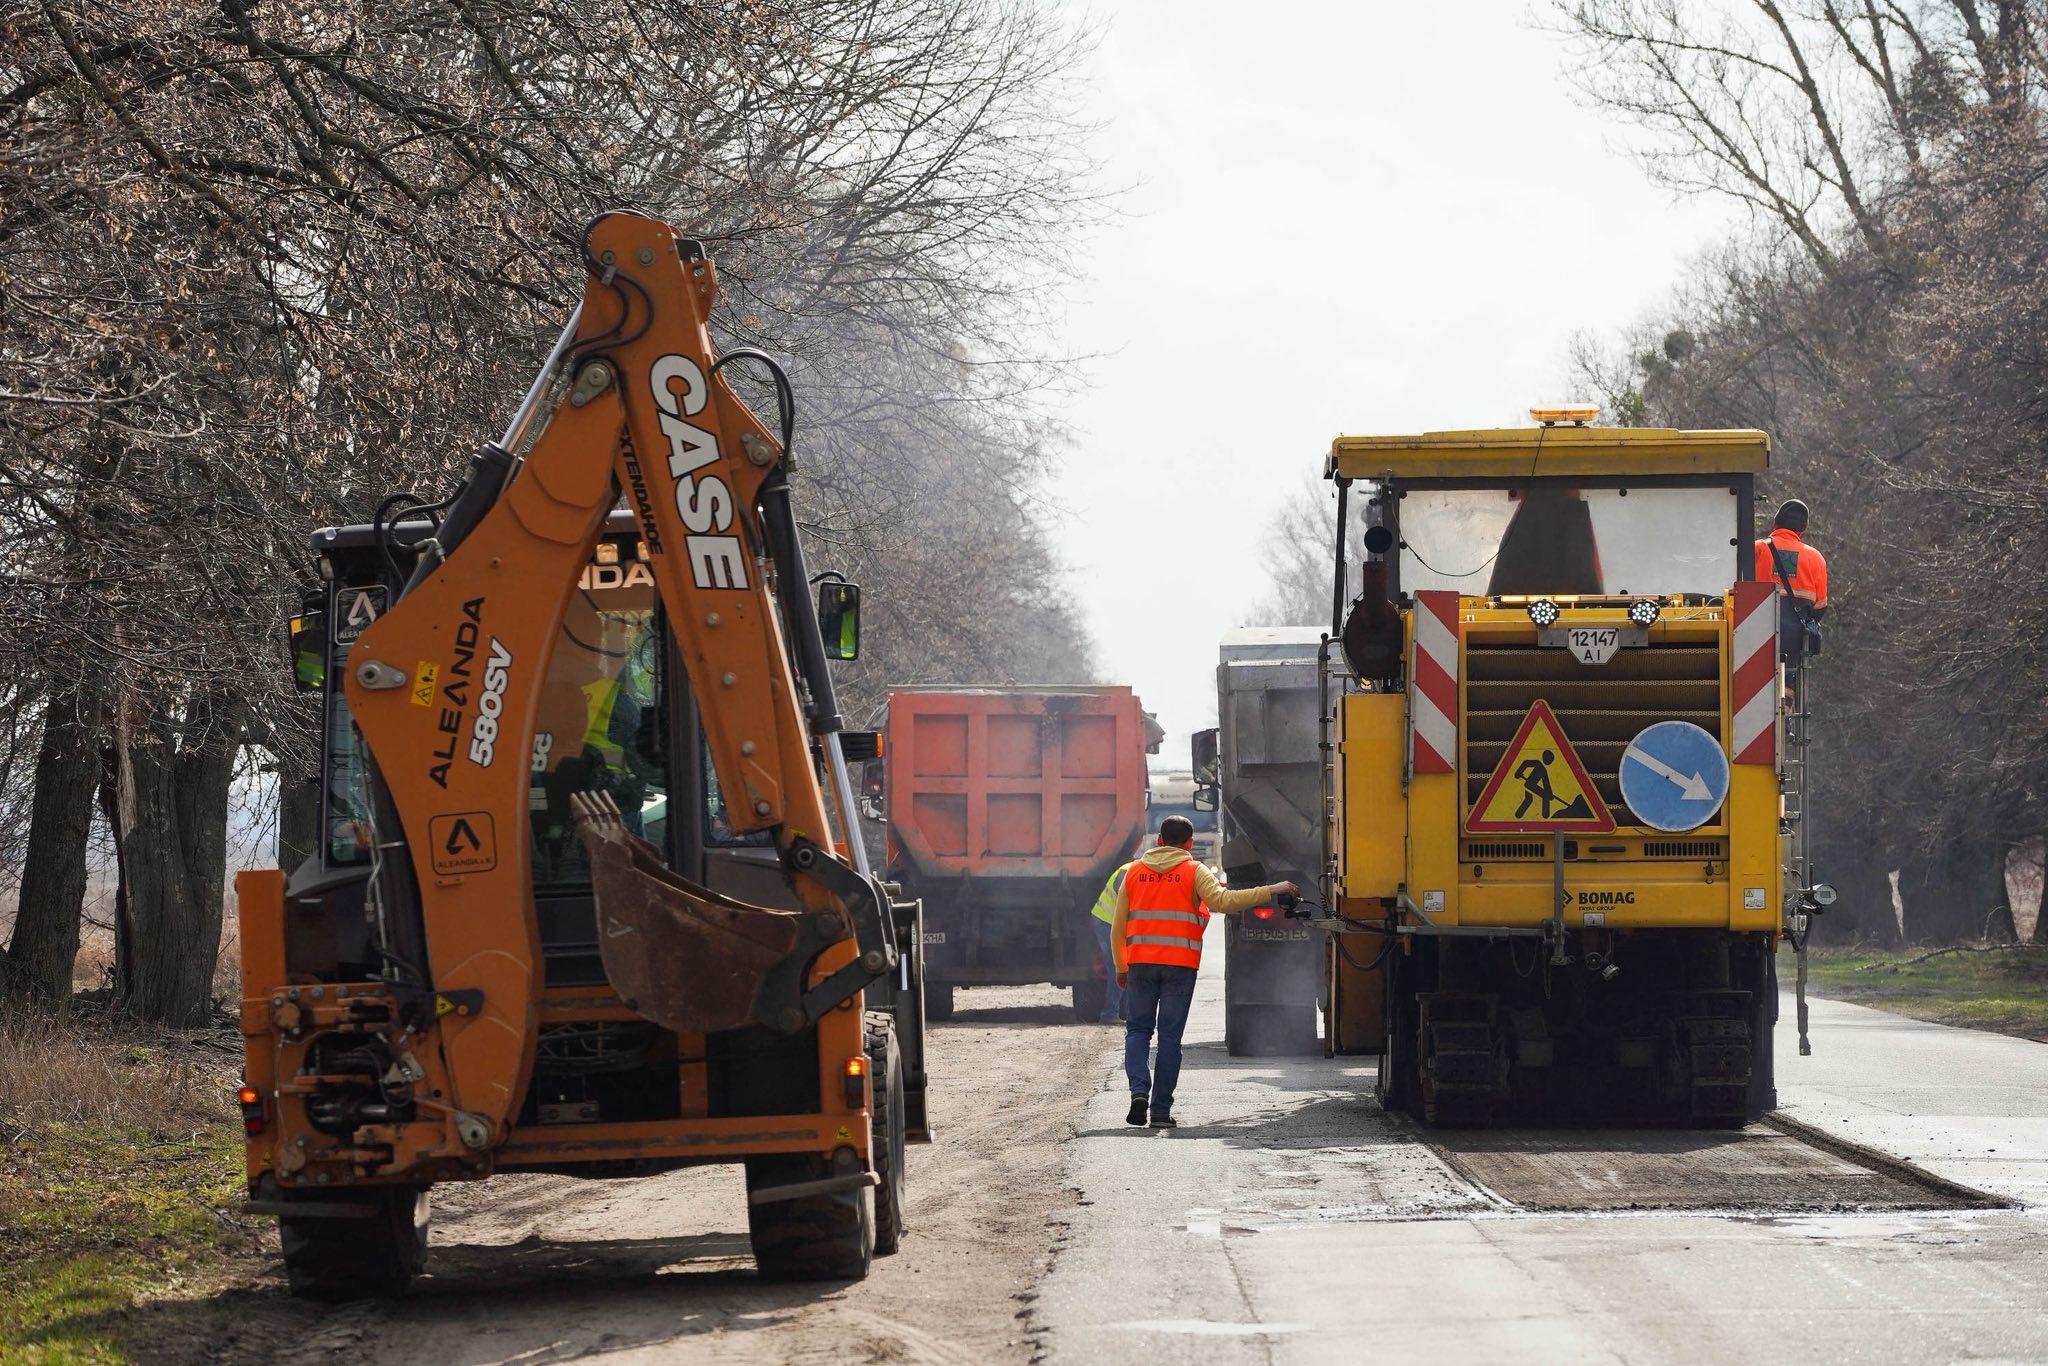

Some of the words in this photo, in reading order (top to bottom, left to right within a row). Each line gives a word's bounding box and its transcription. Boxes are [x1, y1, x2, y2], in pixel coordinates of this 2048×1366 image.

[649, 353, 751, 591] CASE
[1571, 630, 1617, 647] 12147
[1583, 649, 1601, 661] AI
[429, 596, 486, 789] ALEANDA
[467, 634, 514, 769] 580SV
[1578, 891, 1636, 905] BOMAG
